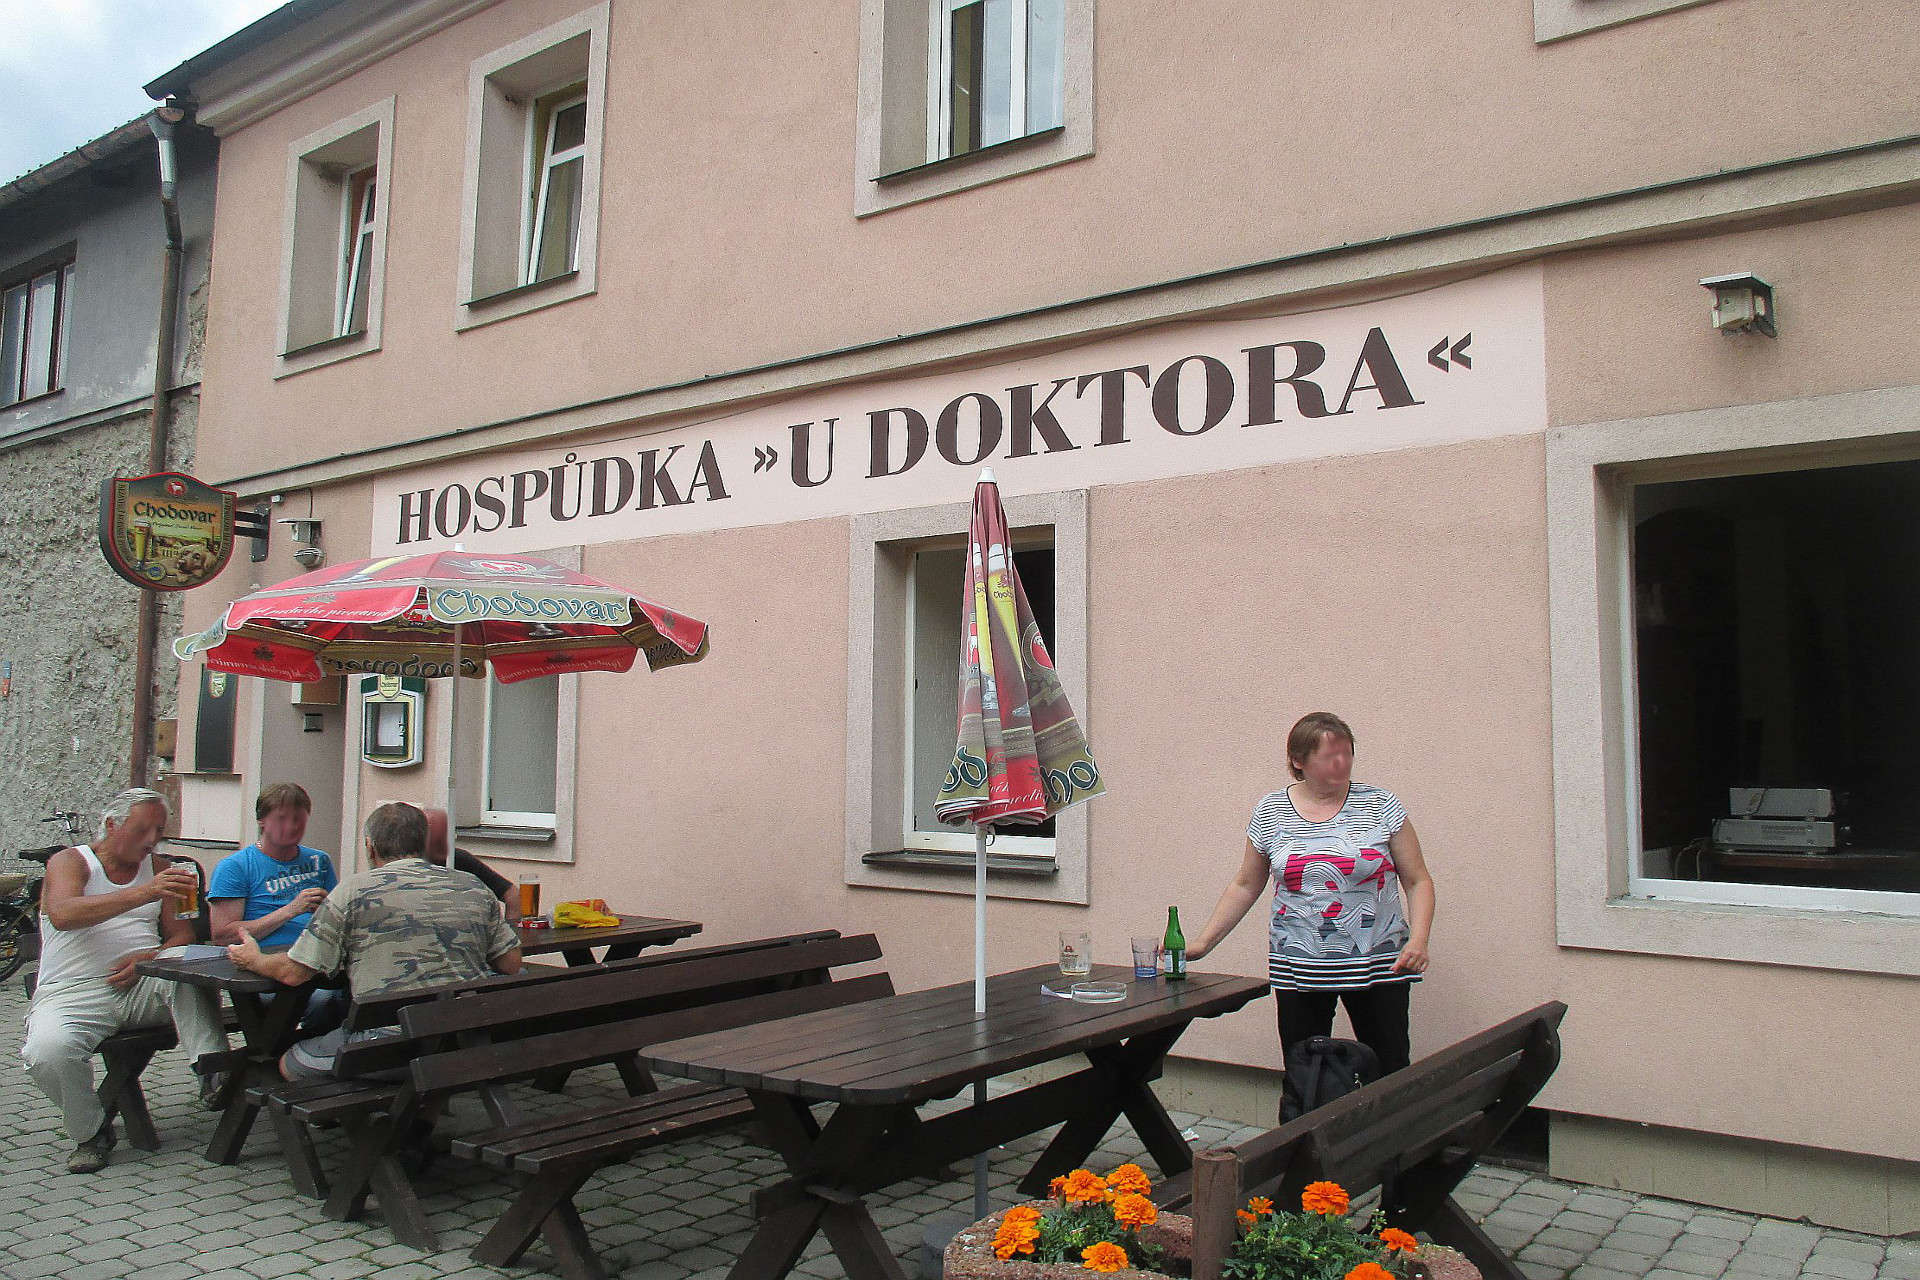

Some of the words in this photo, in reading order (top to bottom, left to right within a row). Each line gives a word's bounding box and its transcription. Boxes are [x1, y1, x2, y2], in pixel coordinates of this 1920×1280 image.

[395, 440, 731, 545] HOSPŮDKA
[134, 501, 216, 523] Chodovar
[436, 588, 624, 622] Chodovar
